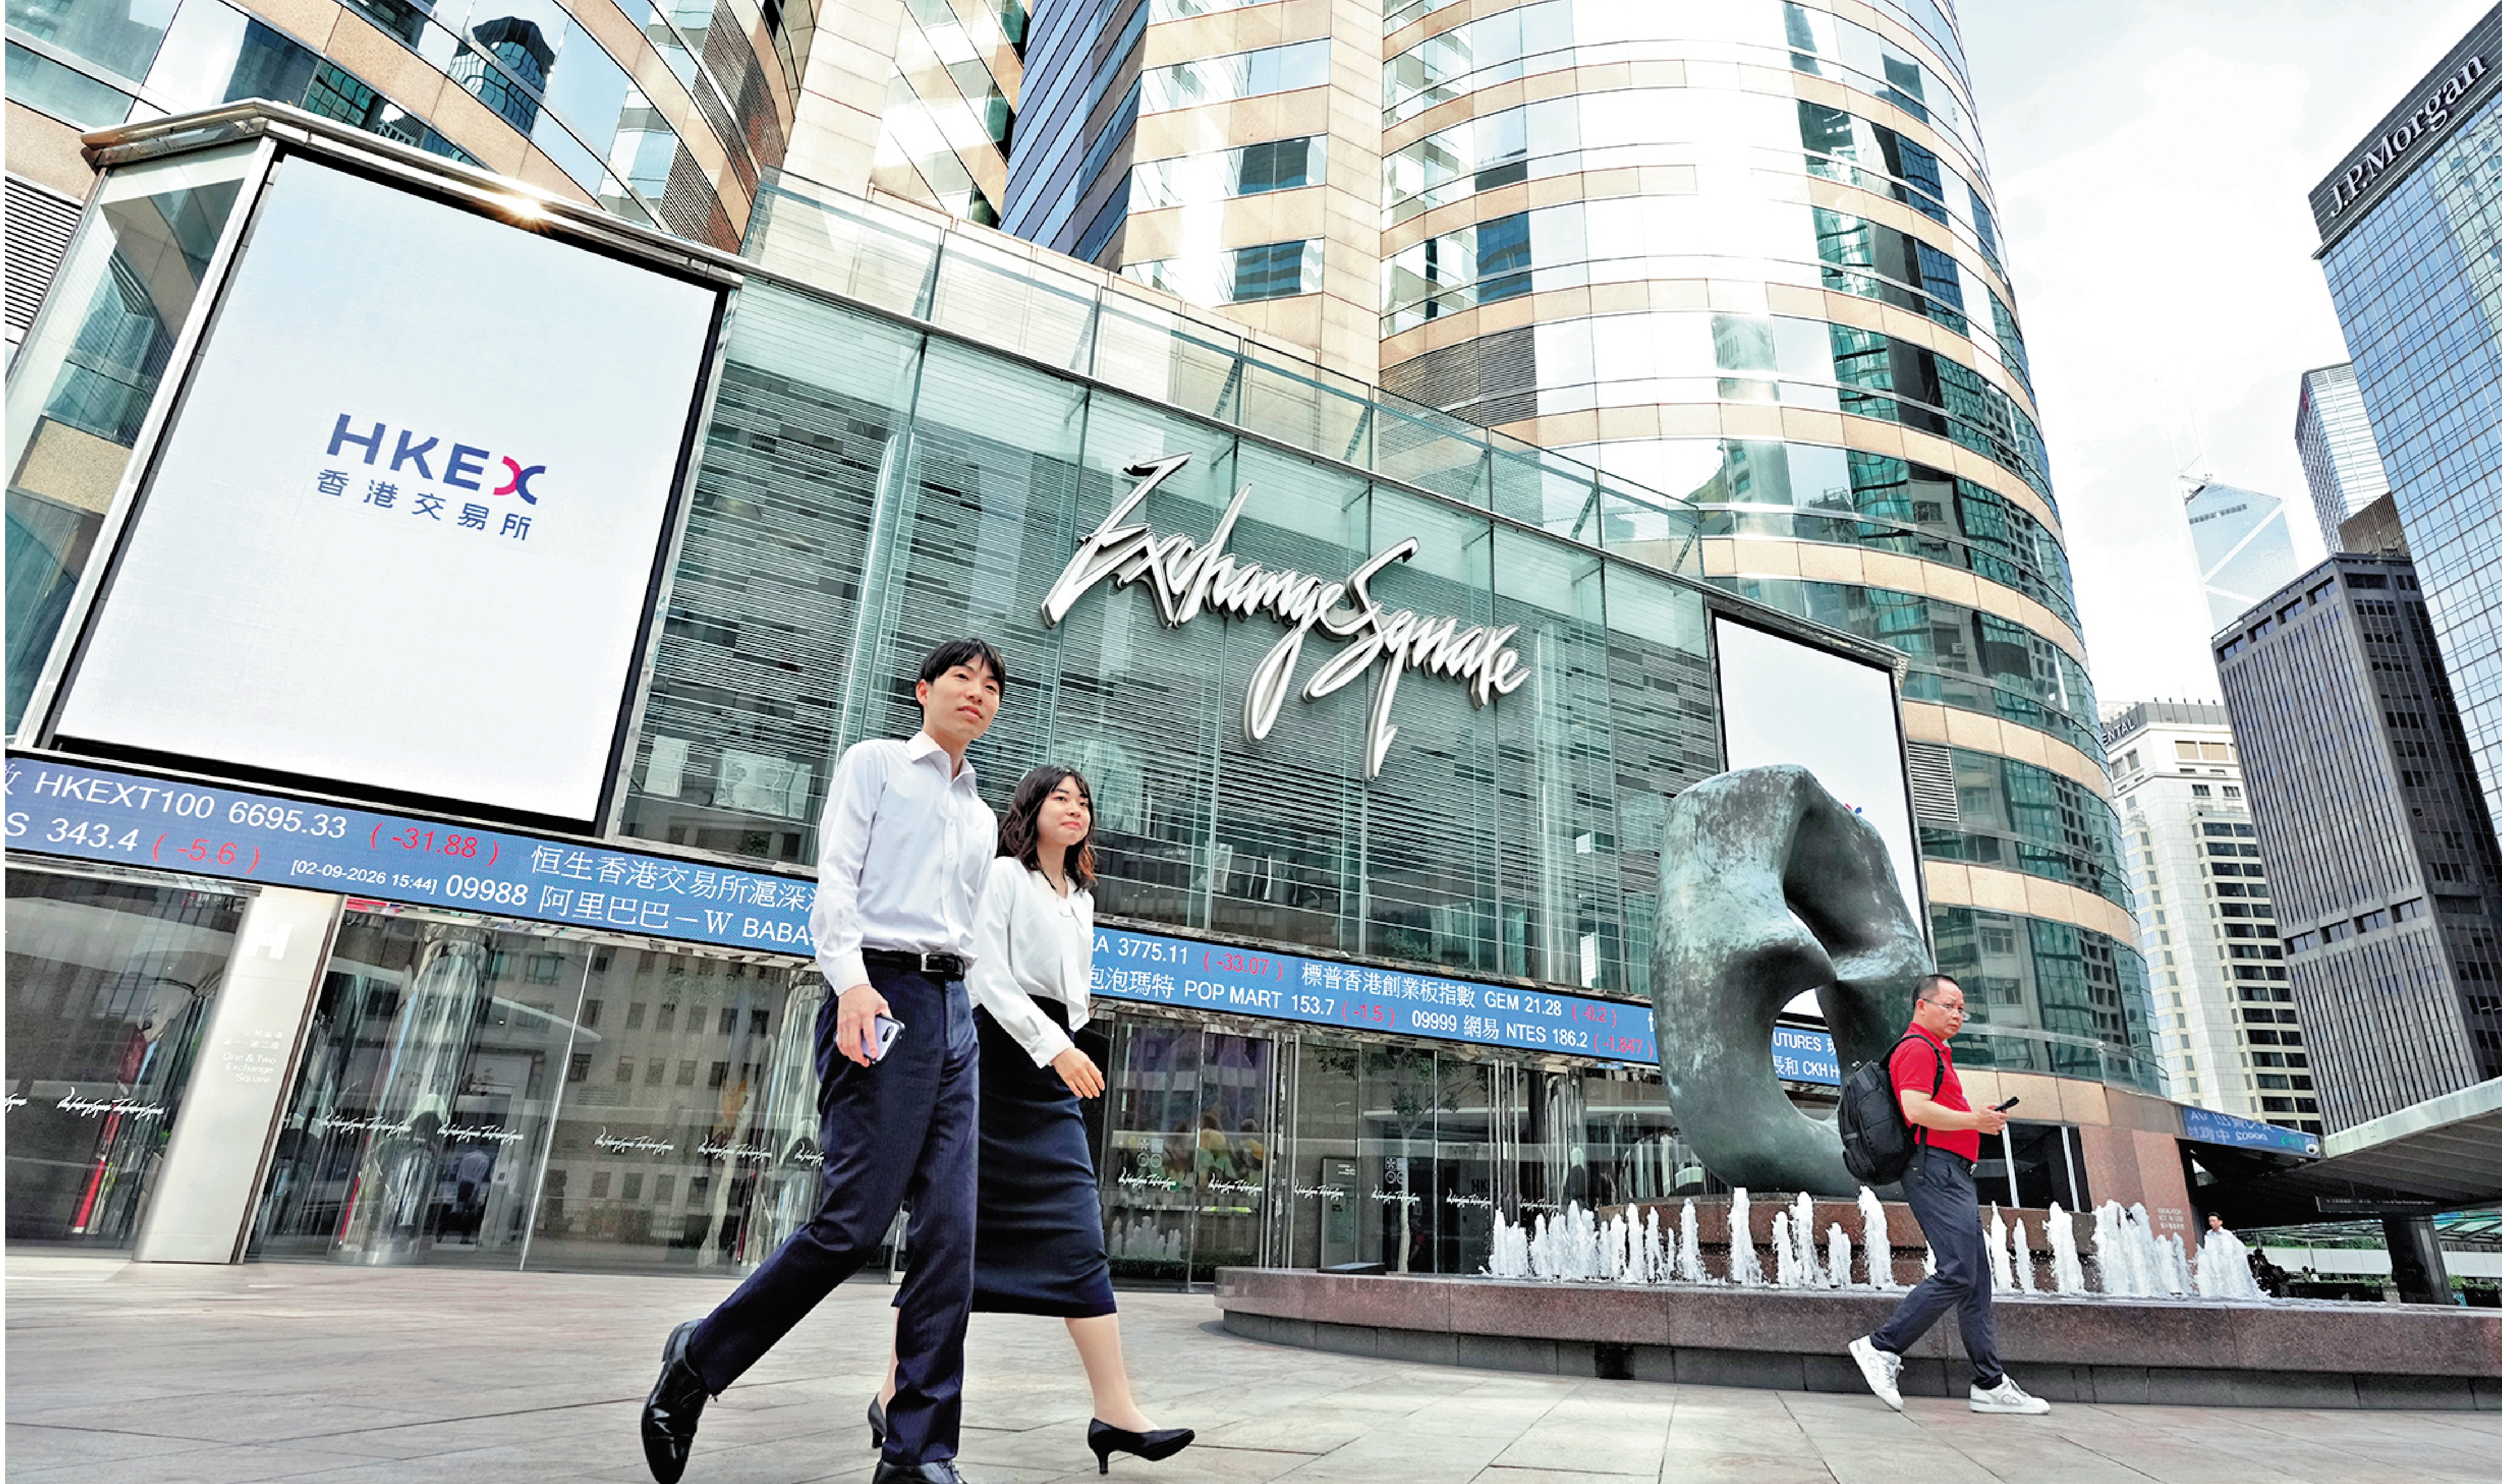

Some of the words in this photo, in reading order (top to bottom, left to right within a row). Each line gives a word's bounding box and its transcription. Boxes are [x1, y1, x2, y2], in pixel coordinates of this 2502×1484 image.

[326, 413, 547, 505] HKEX
[318, 468, 532, 541] 香港交易所
[2103, 719, 2135, 745] ENTAL
[34, 772, 215, 819] HKEXT100
[228, 801, 347, 839] 6695.33
[530, 844, 815, 912] 恒生香港交易所滬深
[46, 818, 139, 851] 343.4
[290, 859, 387, 884] [02-09-2026
[392, 873, 438, 895] 15:44]
[445, 875, 529, 905] 09988
[1118, 937, 1188, 965] 3775.11
[1301, 962, 1476, 1008] 標普香港創業板指數
[1485, 991, 1519, 1010] GEM
[1524, 996, 1562, 1016] 21.28
[1185, 979, 1225, 1001] POP
[1230, 986, 1283, 1009] MART
[1292, 994, 1335, 1016] 153.7
[1412, 1009, 1457, 1032] 09999
[1464, 1014, 1499, 1041] 網易
[1506, 1023, 1547, 1043] NTES
[1552, 1028, 1588, 1048] 186.2
[1773, 1031, 1821, 1052] UTURES
